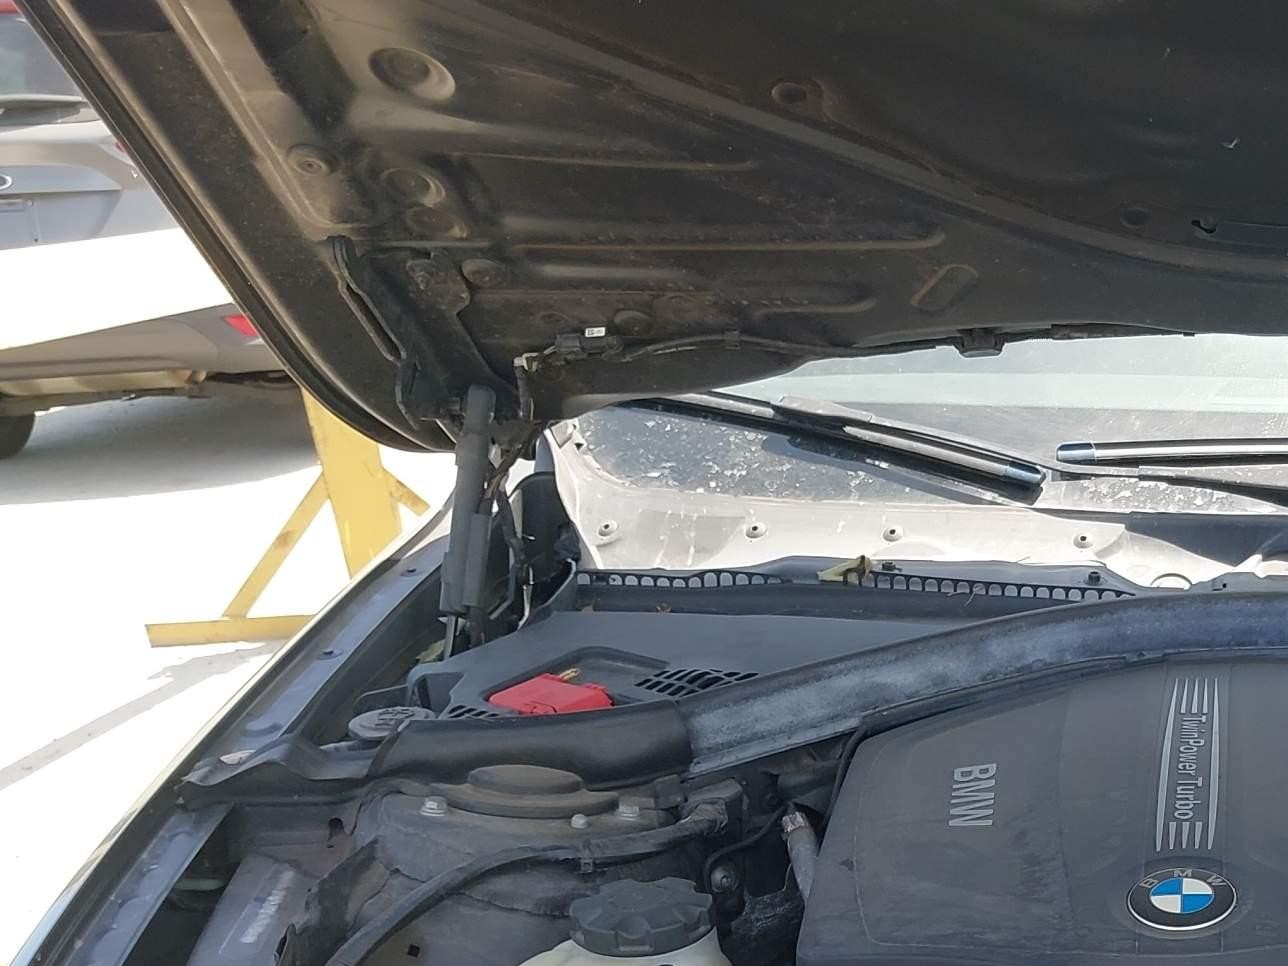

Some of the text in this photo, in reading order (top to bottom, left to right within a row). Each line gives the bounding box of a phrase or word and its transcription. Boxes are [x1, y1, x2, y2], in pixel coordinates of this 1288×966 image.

[948, 763, 997, 826] BMW
[1174, 714, 1206, 820] TwinPower Turbo
[1140, 869, 1226, 889] BMW
